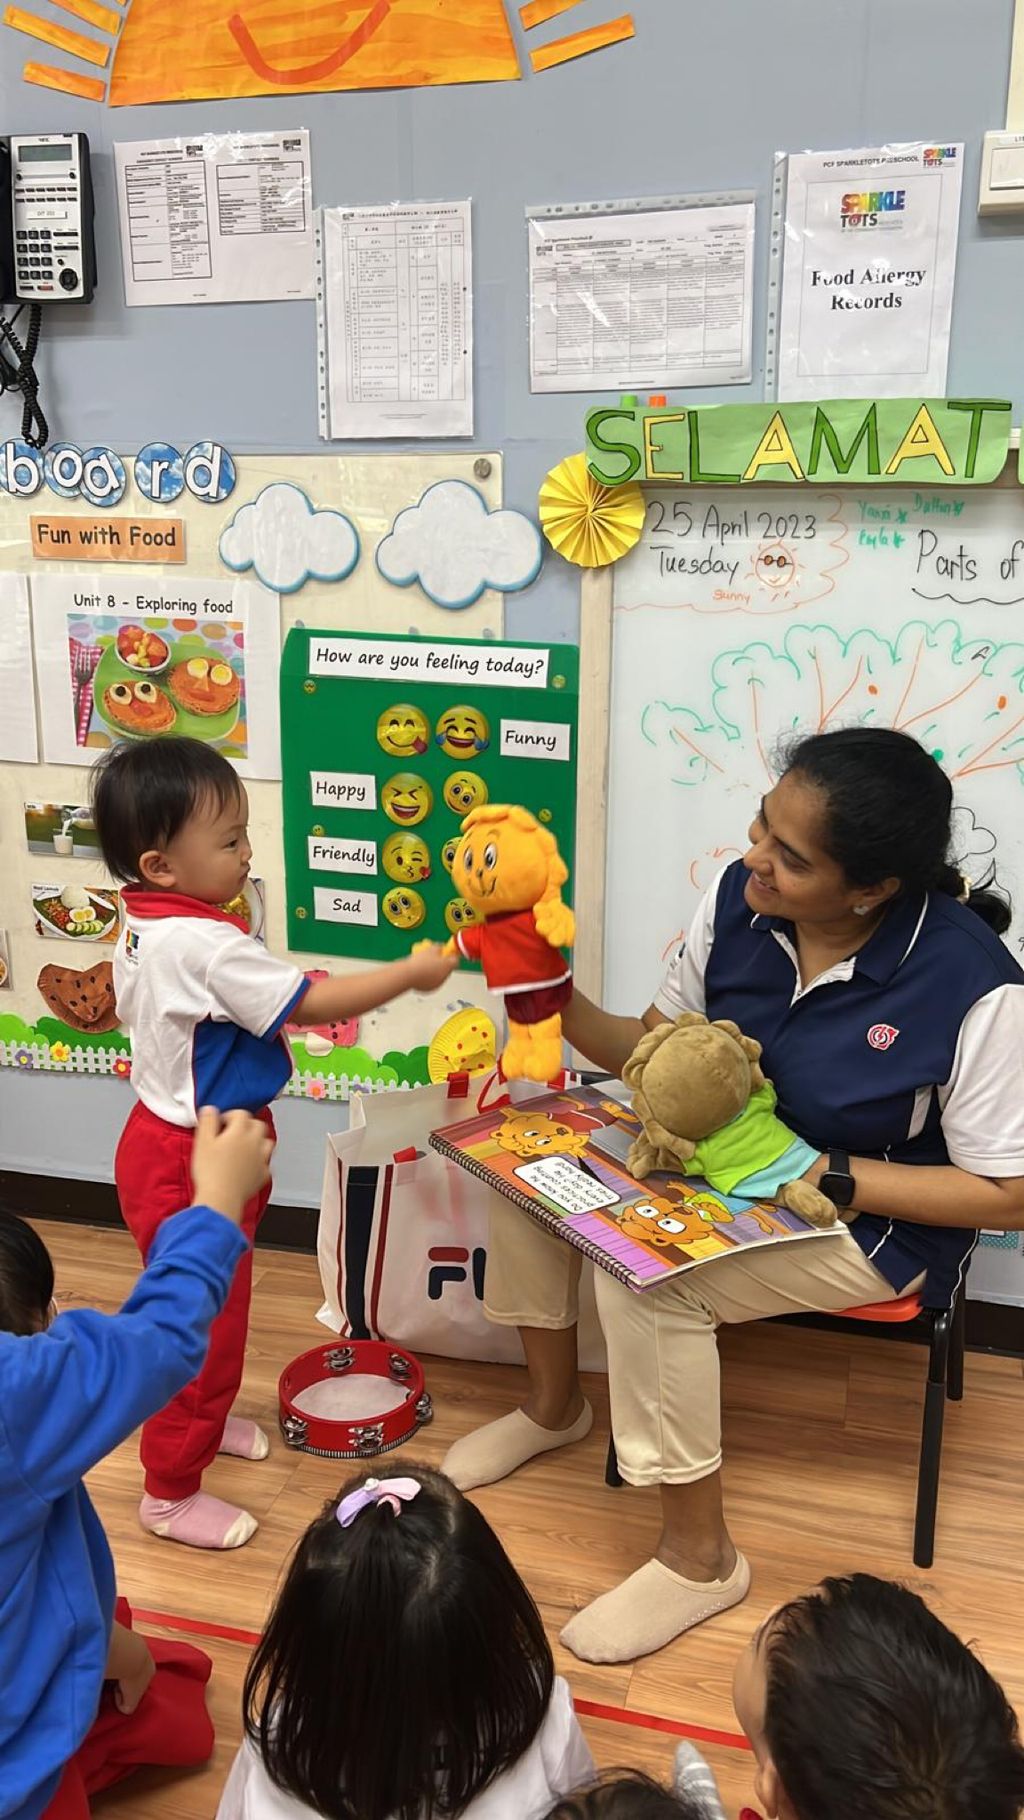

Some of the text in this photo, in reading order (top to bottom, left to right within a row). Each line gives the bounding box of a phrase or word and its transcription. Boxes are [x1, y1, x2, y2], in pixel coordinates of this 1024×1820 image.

[841, 190, 906, 214] SPARKLE
[840, 213, 878, 228] TOTS
[811, 269, 855, 287] Food
[831, 292, 903, 310] Records
[586, 401, 1012, 486] SELAMAT
[5, 442, 223, 499] board
[648, 500, 817, 547] 25 April 2023
[37, 524, 176, 546] Fun with Food
[650, 546, 740, 586] Tuesday
[916, 529, 1024, 581] Parts of
[73, 593, 102, 607] Unit
[107, 595, 116, 608] 8
[136, 595, 198, 616] Exploring
[203, 598, 233, 614] food
[316, 647, 545, 679] How are you feeling today?
[504, 730, 557, 752] Funny
[316, 780, 366, 802] Happy
[313, 845, 375, 867] Friendly
[332, 898, 362, 914] Sad
